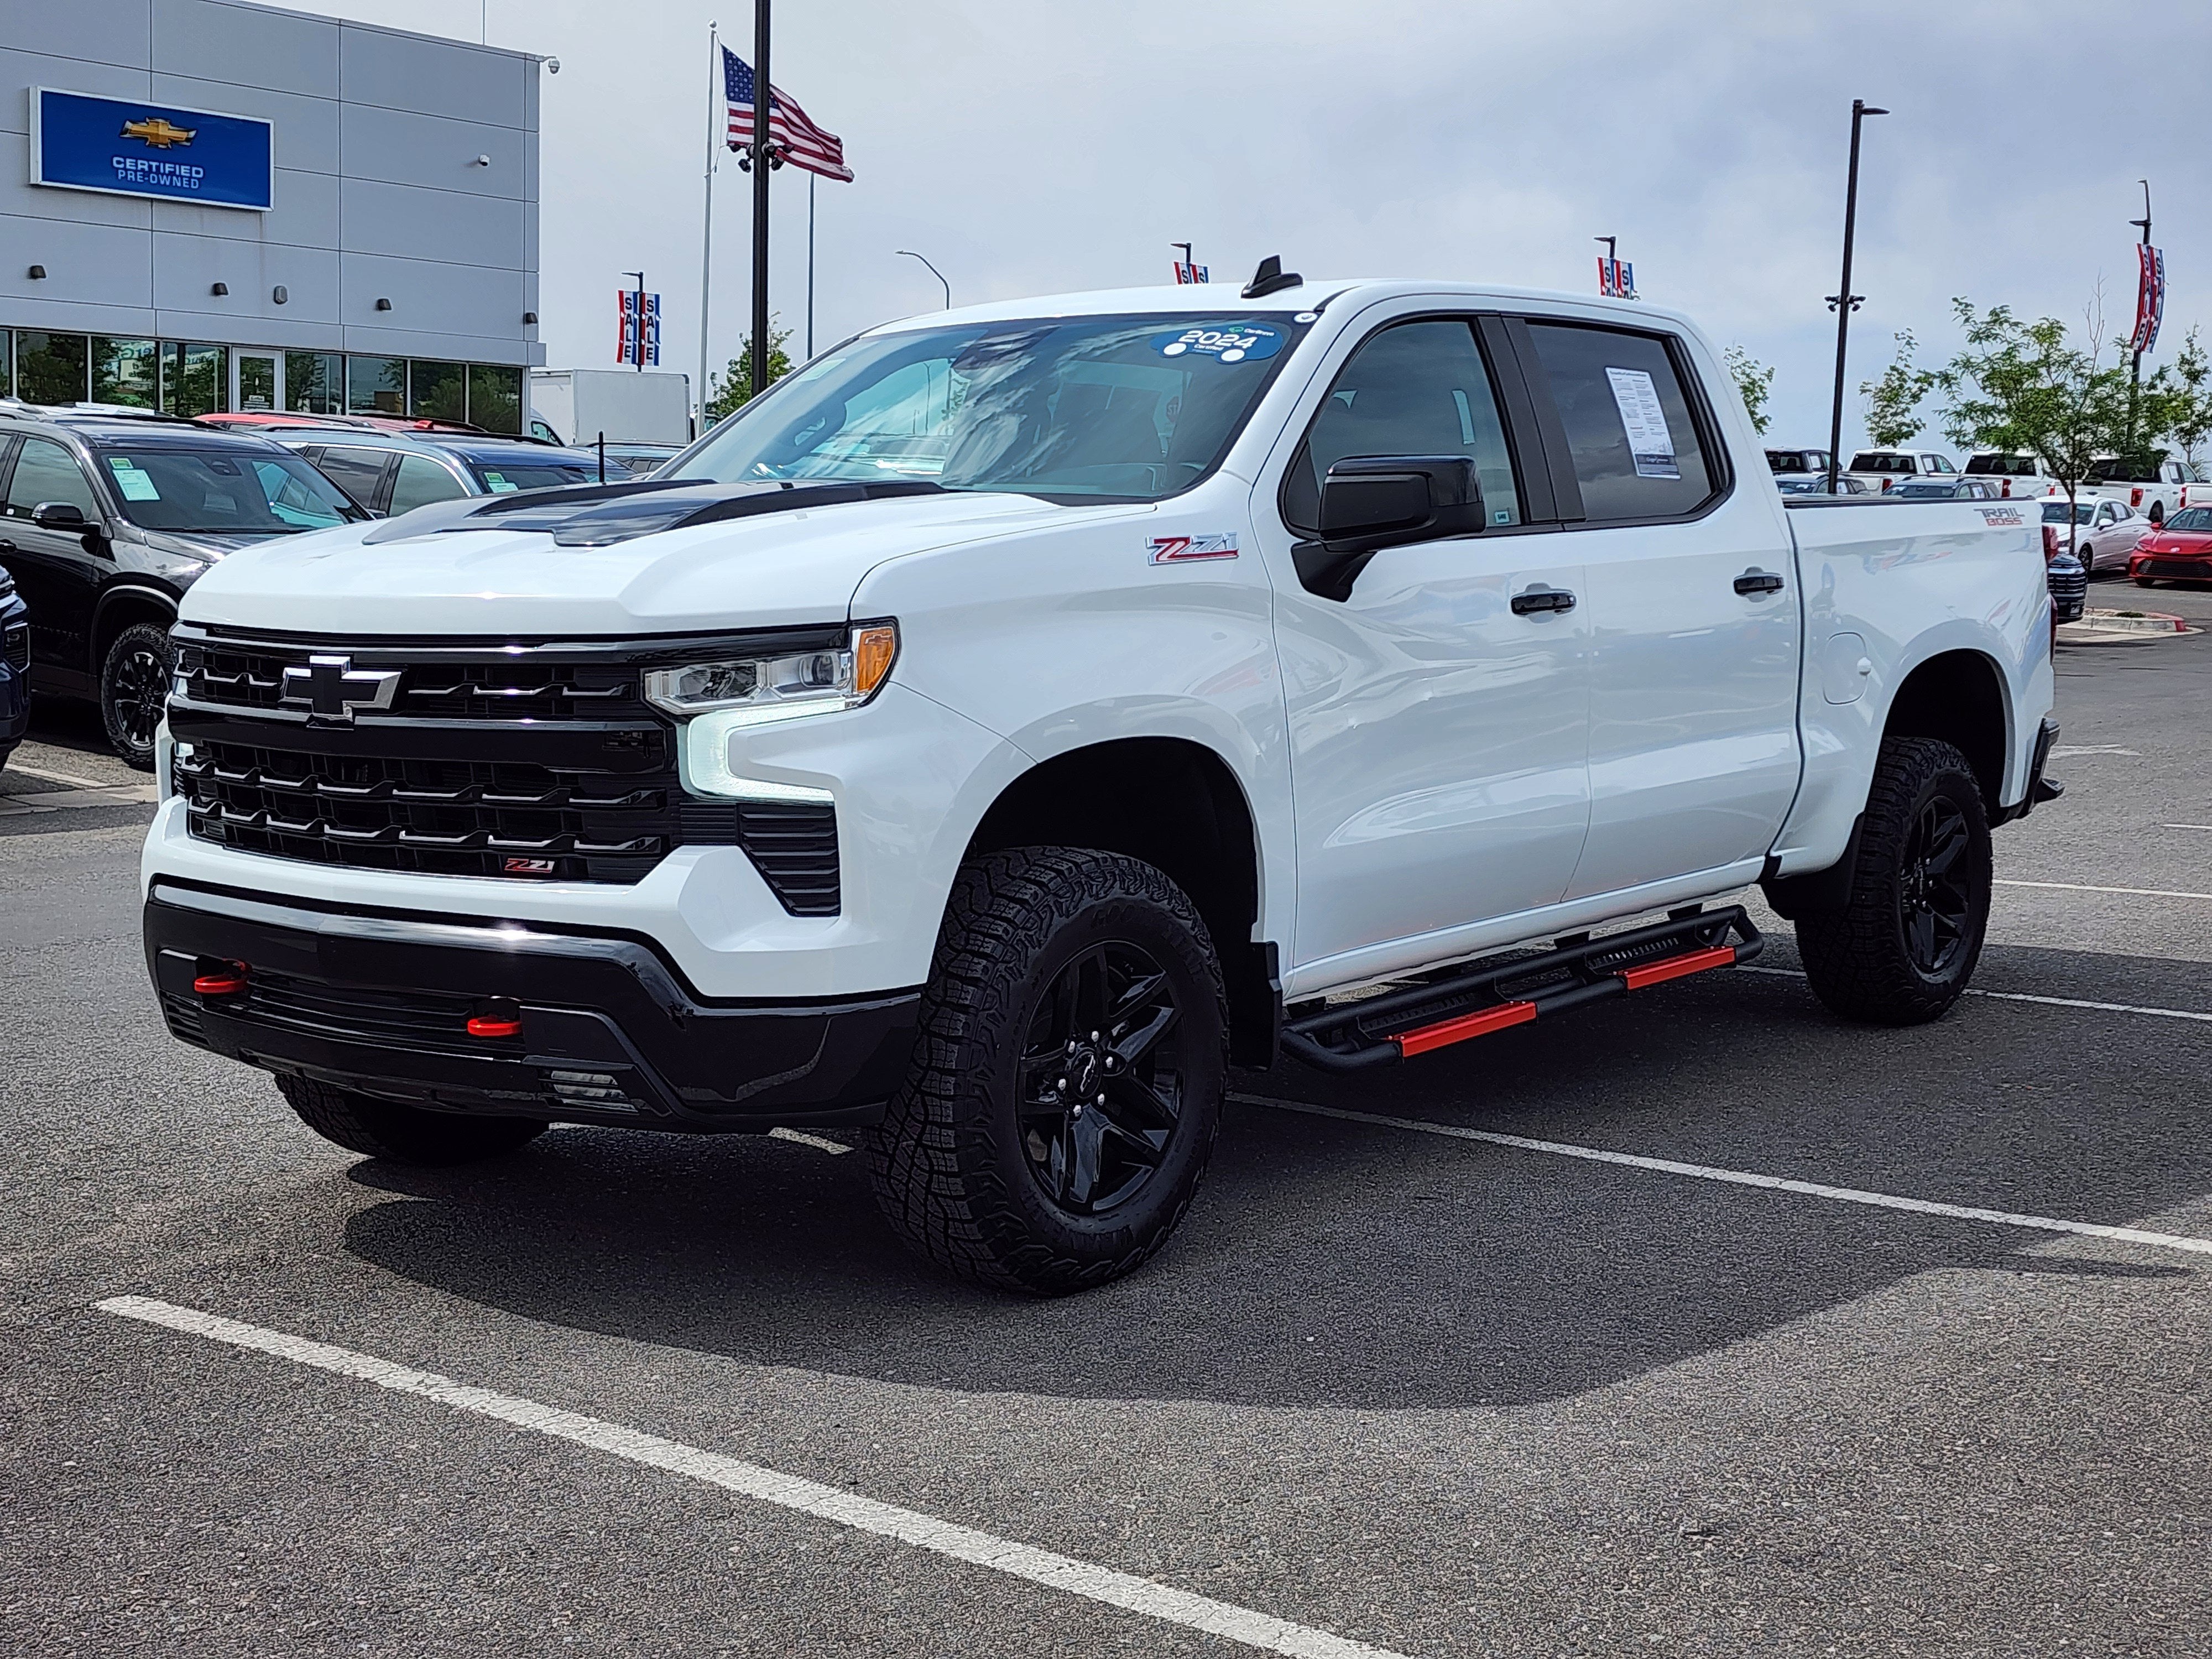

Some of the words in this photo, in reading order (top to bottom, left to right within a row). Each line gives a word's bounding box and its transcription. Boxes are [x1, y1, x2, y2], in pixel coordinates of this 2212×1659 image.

[113, 156, 204, 178] CERTIFIED
[118, 169, 199, 189] PRE-OWNED
[624, 297, 633, 358] SALE
[646, 299, 654, 360] SALE
[1178, 330, 1258, 349] 2024
[1973, 507, 2026, 518] TRAIL
[1985, 517, 2023, 526] BOSS
[1145, 532, 1239, 566] Z71
[504, 858, 555, 873] Z71
